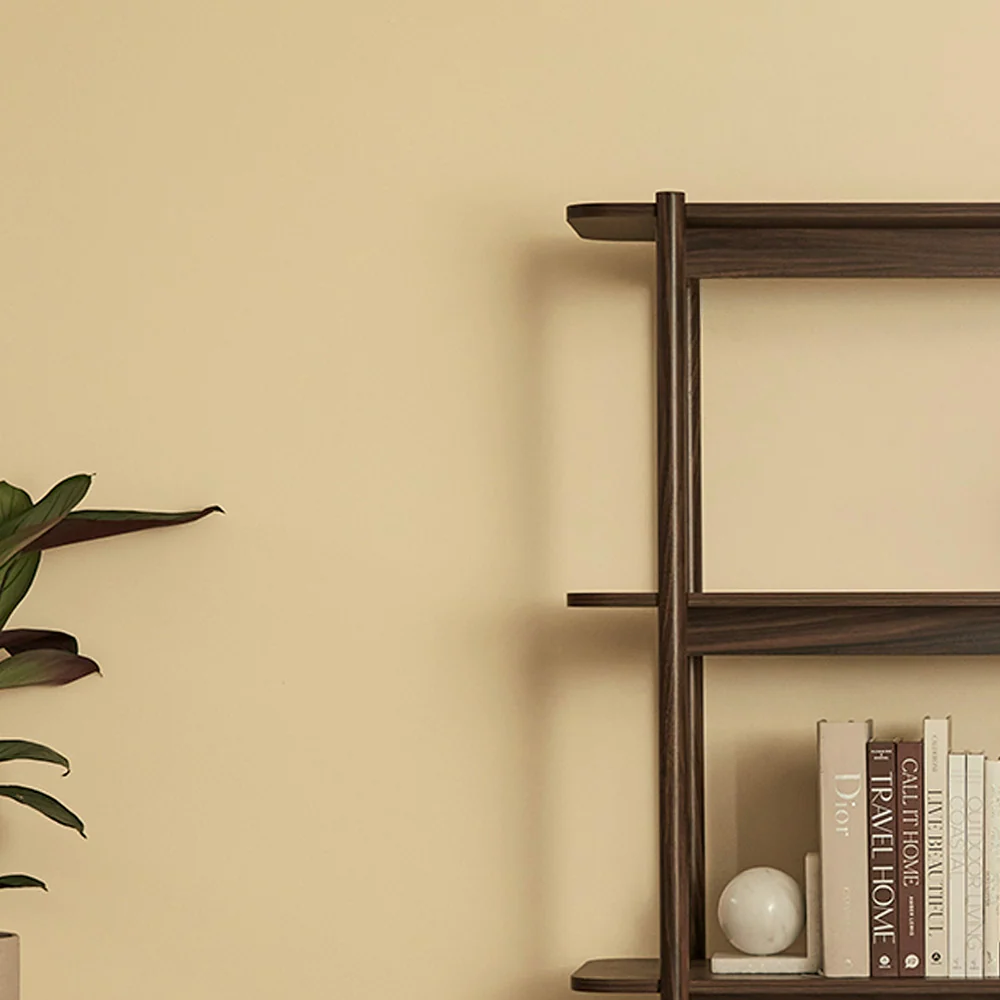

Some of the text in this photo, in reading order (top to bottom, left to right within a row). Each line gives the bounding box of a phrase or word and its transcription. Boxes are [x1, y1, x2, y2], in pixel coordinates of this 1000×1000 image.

[834, 773, 862, 837] Dior
[870, 771, 894, 859] TRAVEL
[902, 758, 921, 887] CALL IT HOME
[967, 796, 982, 888] OUTDOOR
[872, 866, 896, 944] HOME
[928, 790, 944, 937] LIVE BEAUTIFUL
[967, 894, 982, 951] LIVING
